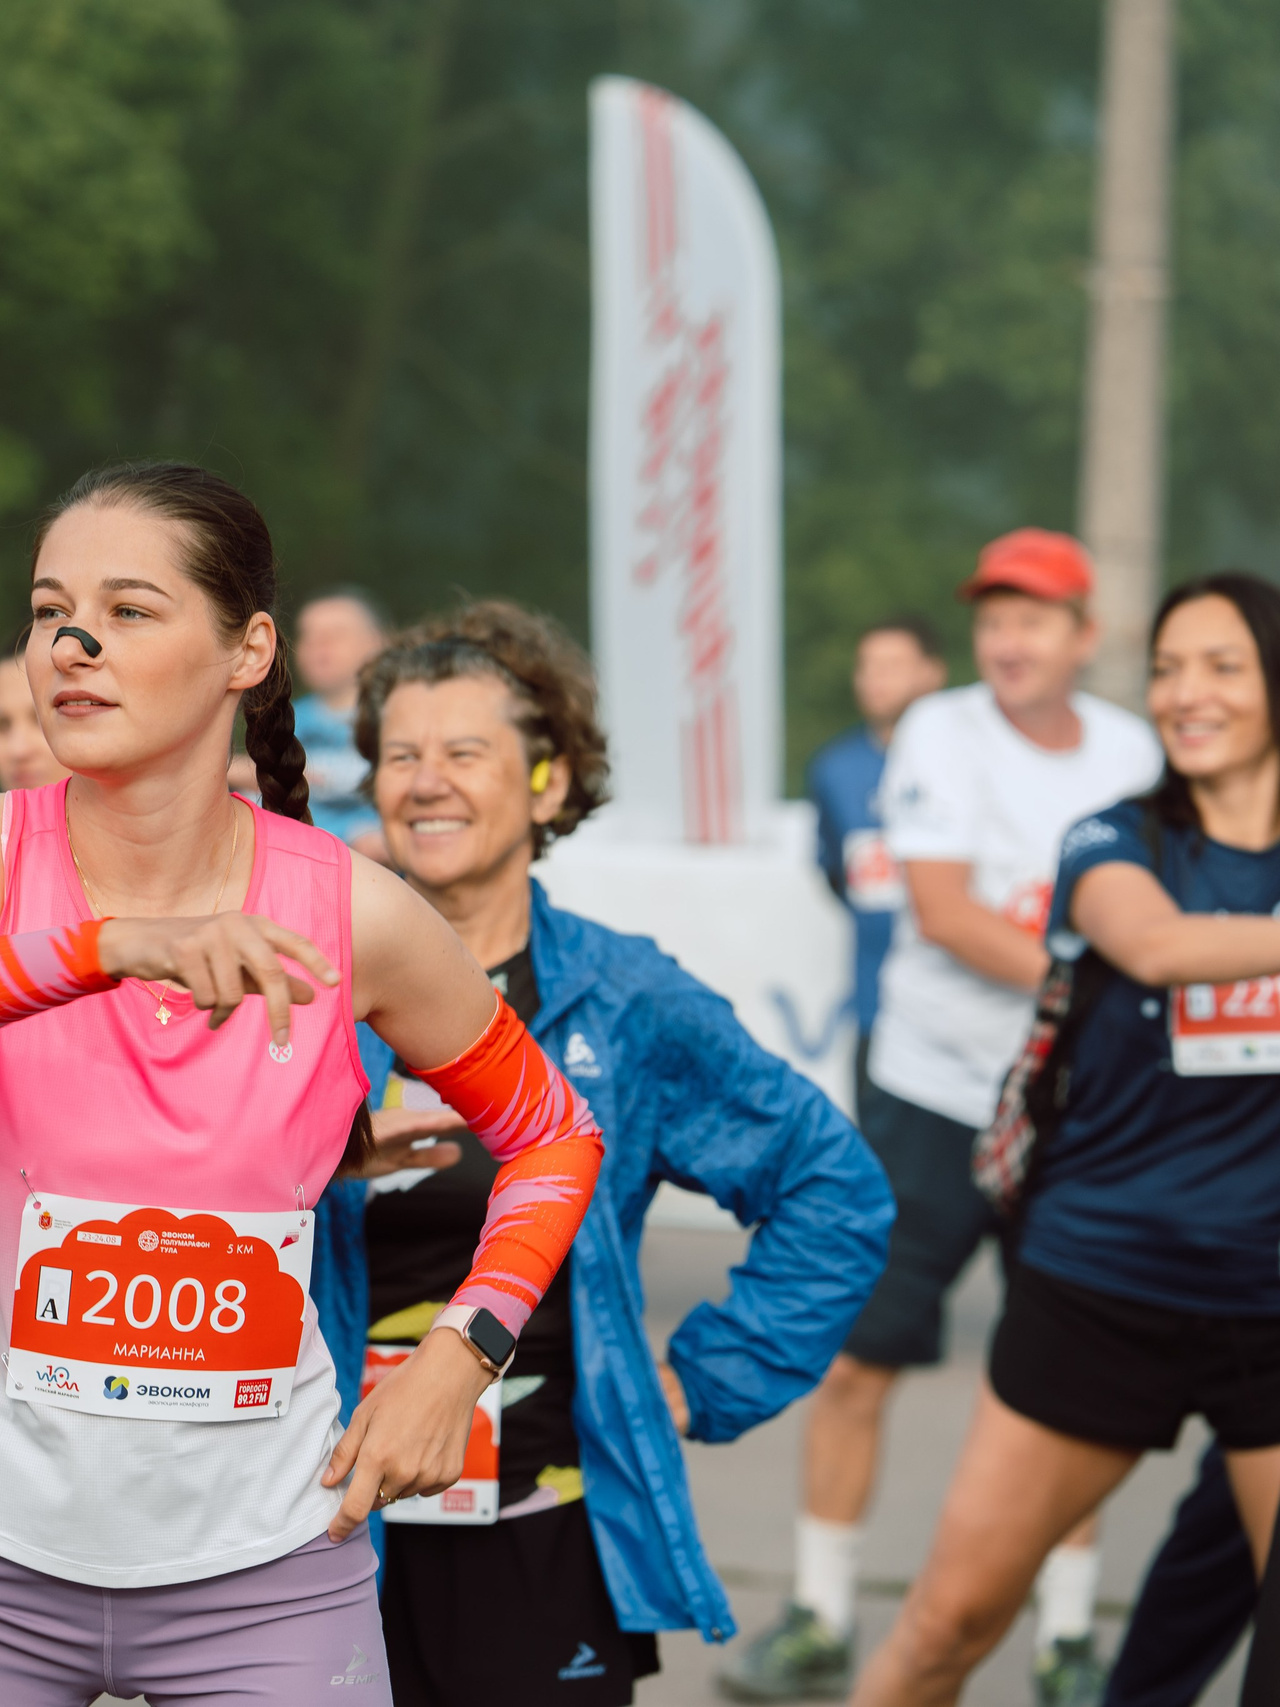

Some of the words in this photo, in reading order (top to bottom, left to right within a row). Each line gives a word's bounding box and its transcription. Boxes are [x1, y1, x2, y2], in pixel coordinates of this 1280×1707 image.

[81, 1232, 117, 1244] 23-24.08
[161, 1231, 195, 1240] ЭВОКОМ
[160, 1239, 211, 1249] ПОЛУМАРАФОН
[226, 1244, 234, 1254] 5
[160, 1246, 178, 1254] ТУЛА
[81, 1269, 247, 1334] 2008
[113, 1342, 206, 1362] МАРИАННА
[136, 1384, 211, 1399] ЭВОКОМ
[239, 1384, 269, 1394] ГОРДОСТЬ
[237, 1393, 254, 1405] 89.2
[255, 1392, 267, 1403] FM
